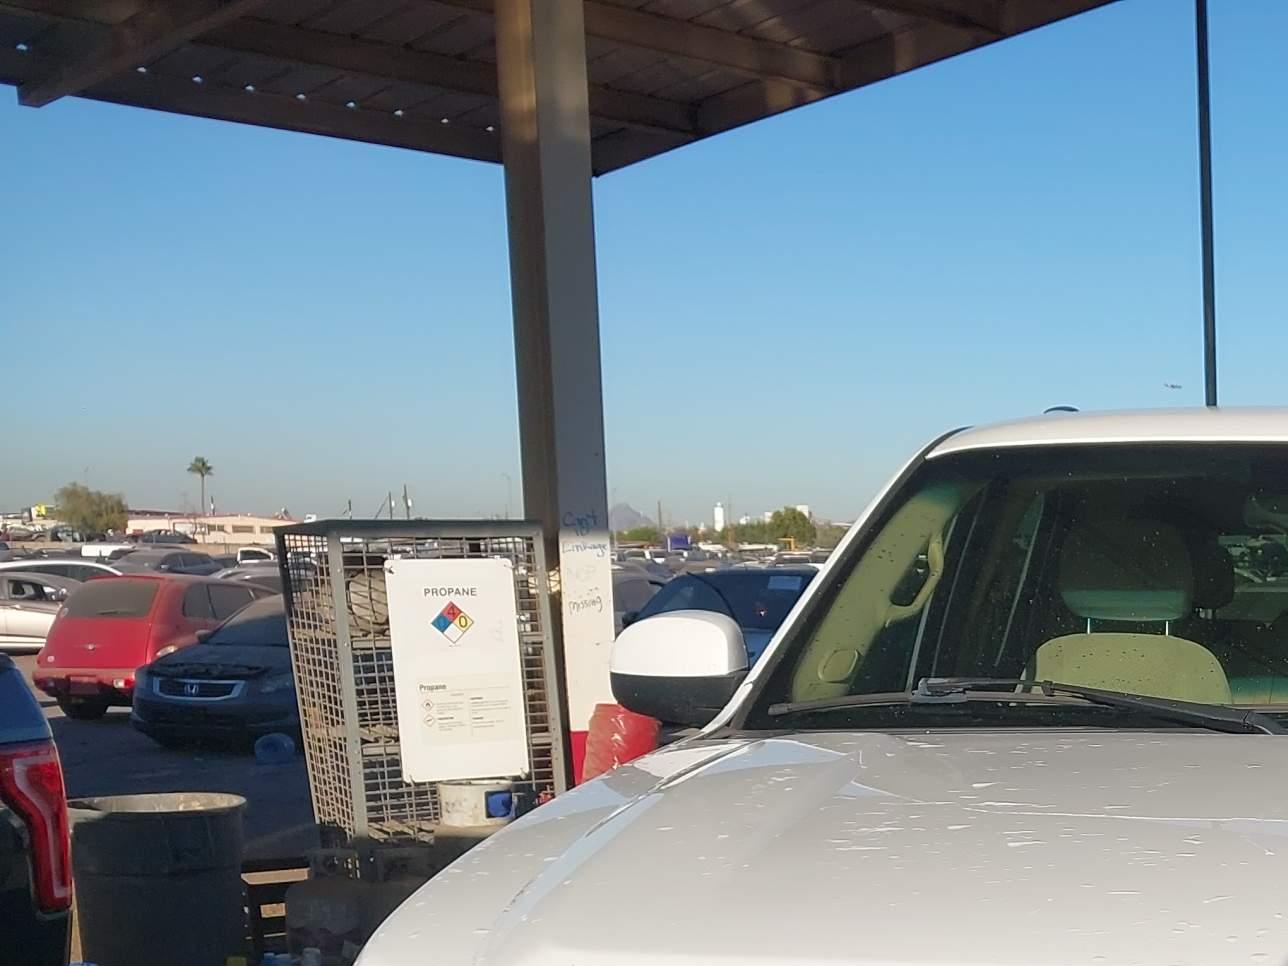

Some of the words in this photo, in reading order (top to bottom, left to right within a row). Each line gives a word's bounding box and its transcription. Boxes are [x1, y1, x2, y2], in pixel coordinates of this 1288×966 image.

[423, 587, 478, 597] PROPANE
[458, 615, 468, 628] 0
[419, 684, 447, 692] Propane
